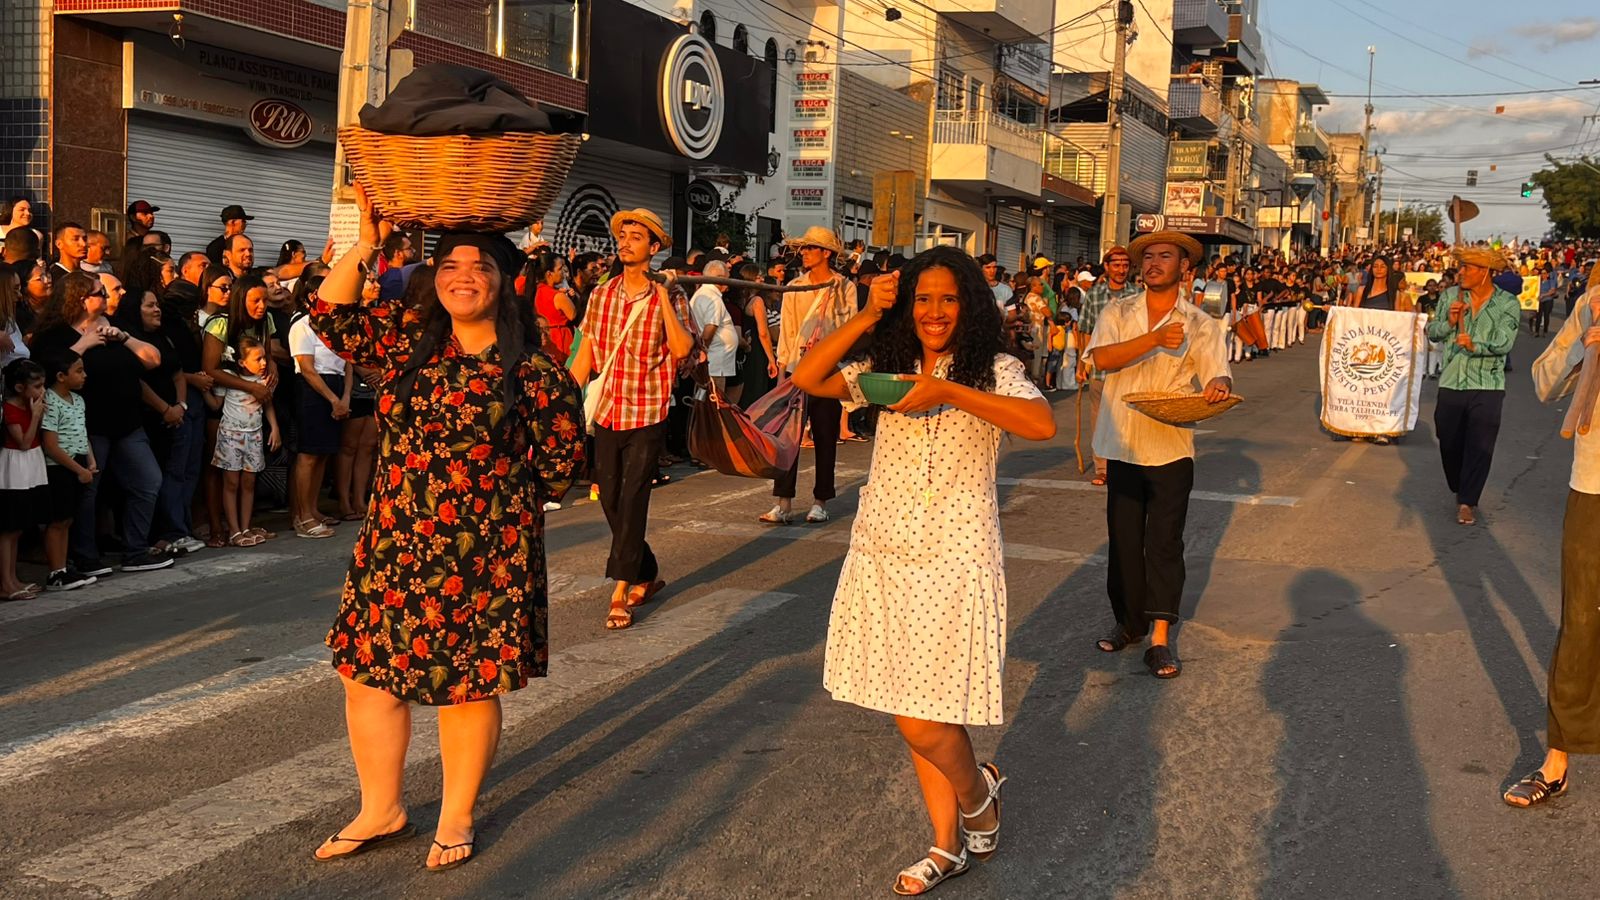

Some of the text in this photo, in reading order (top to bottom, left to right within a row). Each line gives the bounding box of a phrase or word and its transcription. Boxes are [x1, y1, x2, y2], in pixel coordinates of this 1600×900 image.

[200, 50, 236, 70] PLANO
[238, 60, 310, 86] ASSISTENCIAL
[690, 192, 711, 204] DNZ
[1138, 218, 1154, 228] DNZ
[1332, 325, 1405, 360] BANDA MARCIAL
[1332, 360, 1404, 395] FAUSTO PEREIRA
[1337, 398, 1388, 409] VILA LUANDA
